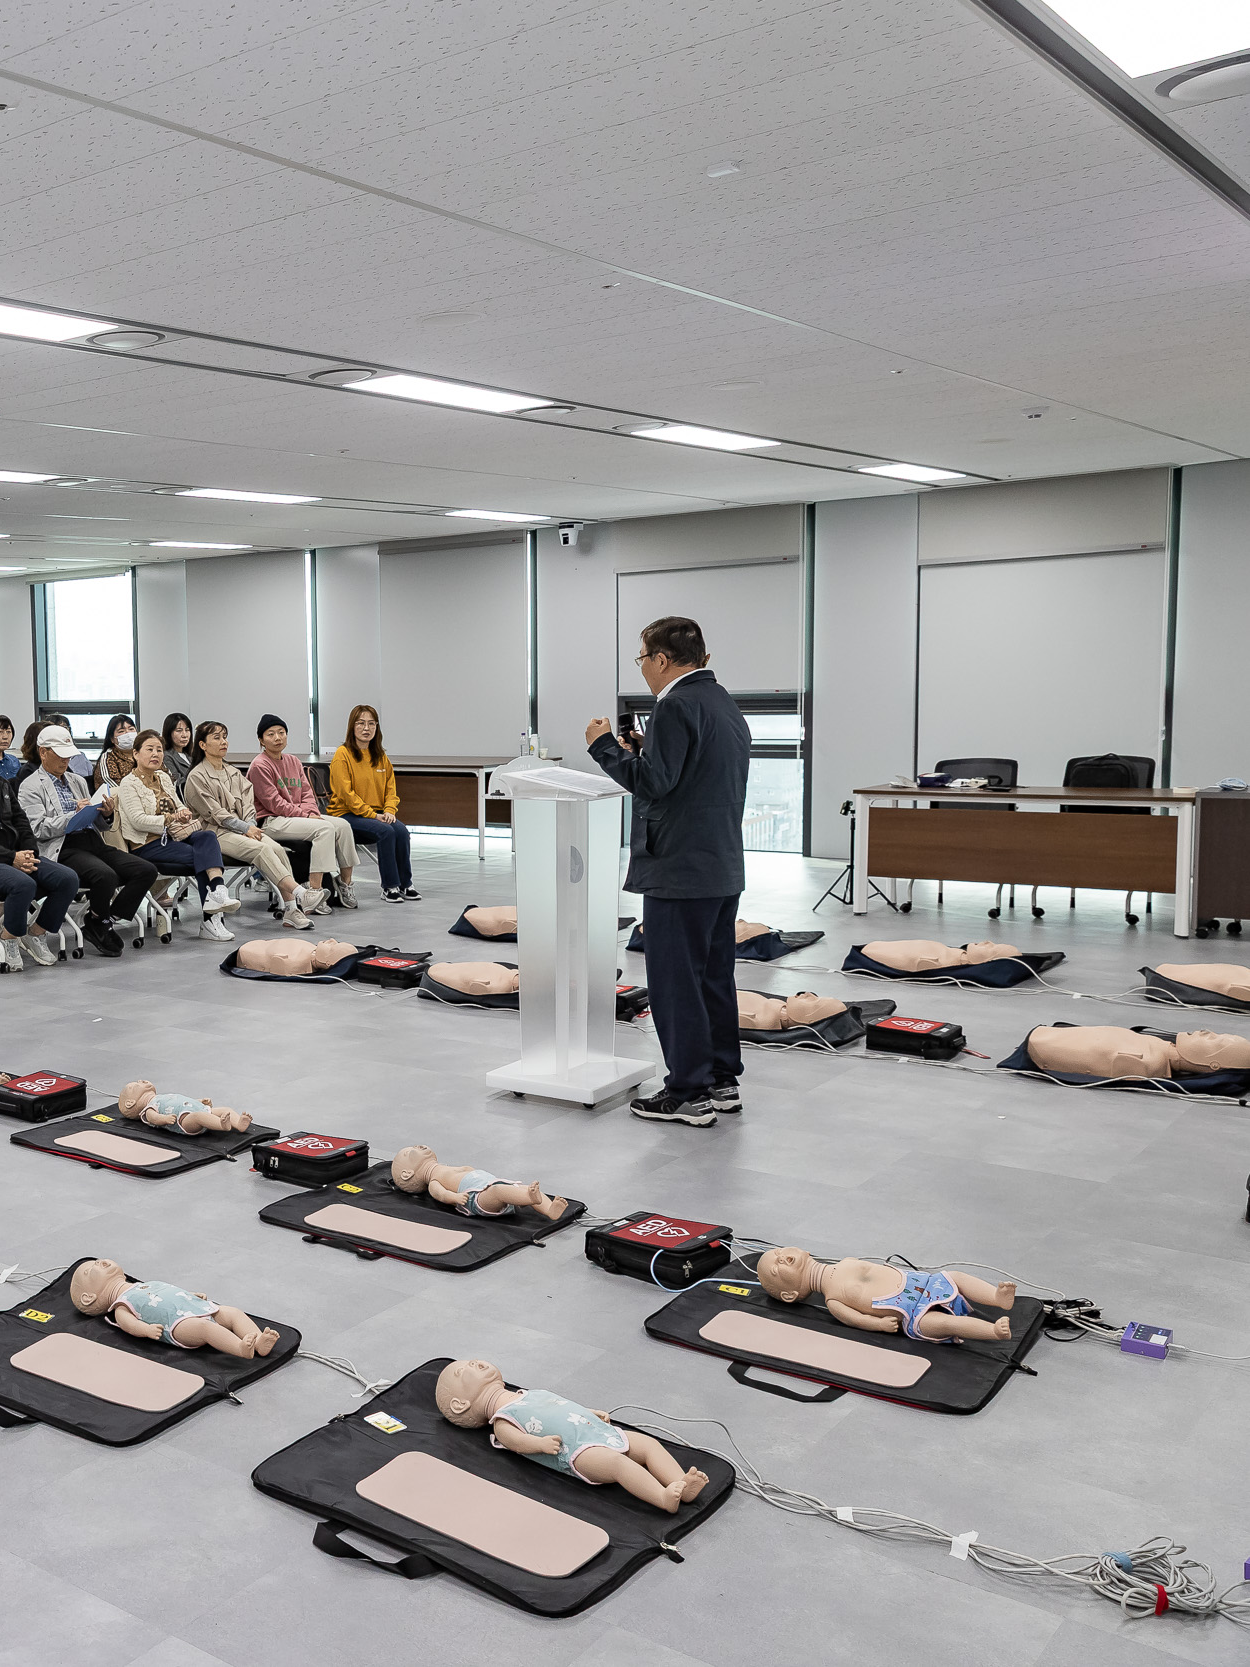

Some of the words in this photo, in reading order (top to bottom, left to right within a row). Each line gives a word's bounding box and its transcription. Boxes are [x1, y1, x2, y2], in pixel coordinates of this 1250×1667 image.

[16, 1081, 50, 1093] AED
[629, 1219, 667, 1236] AED
[26, 1310, 49, 1320] D2
